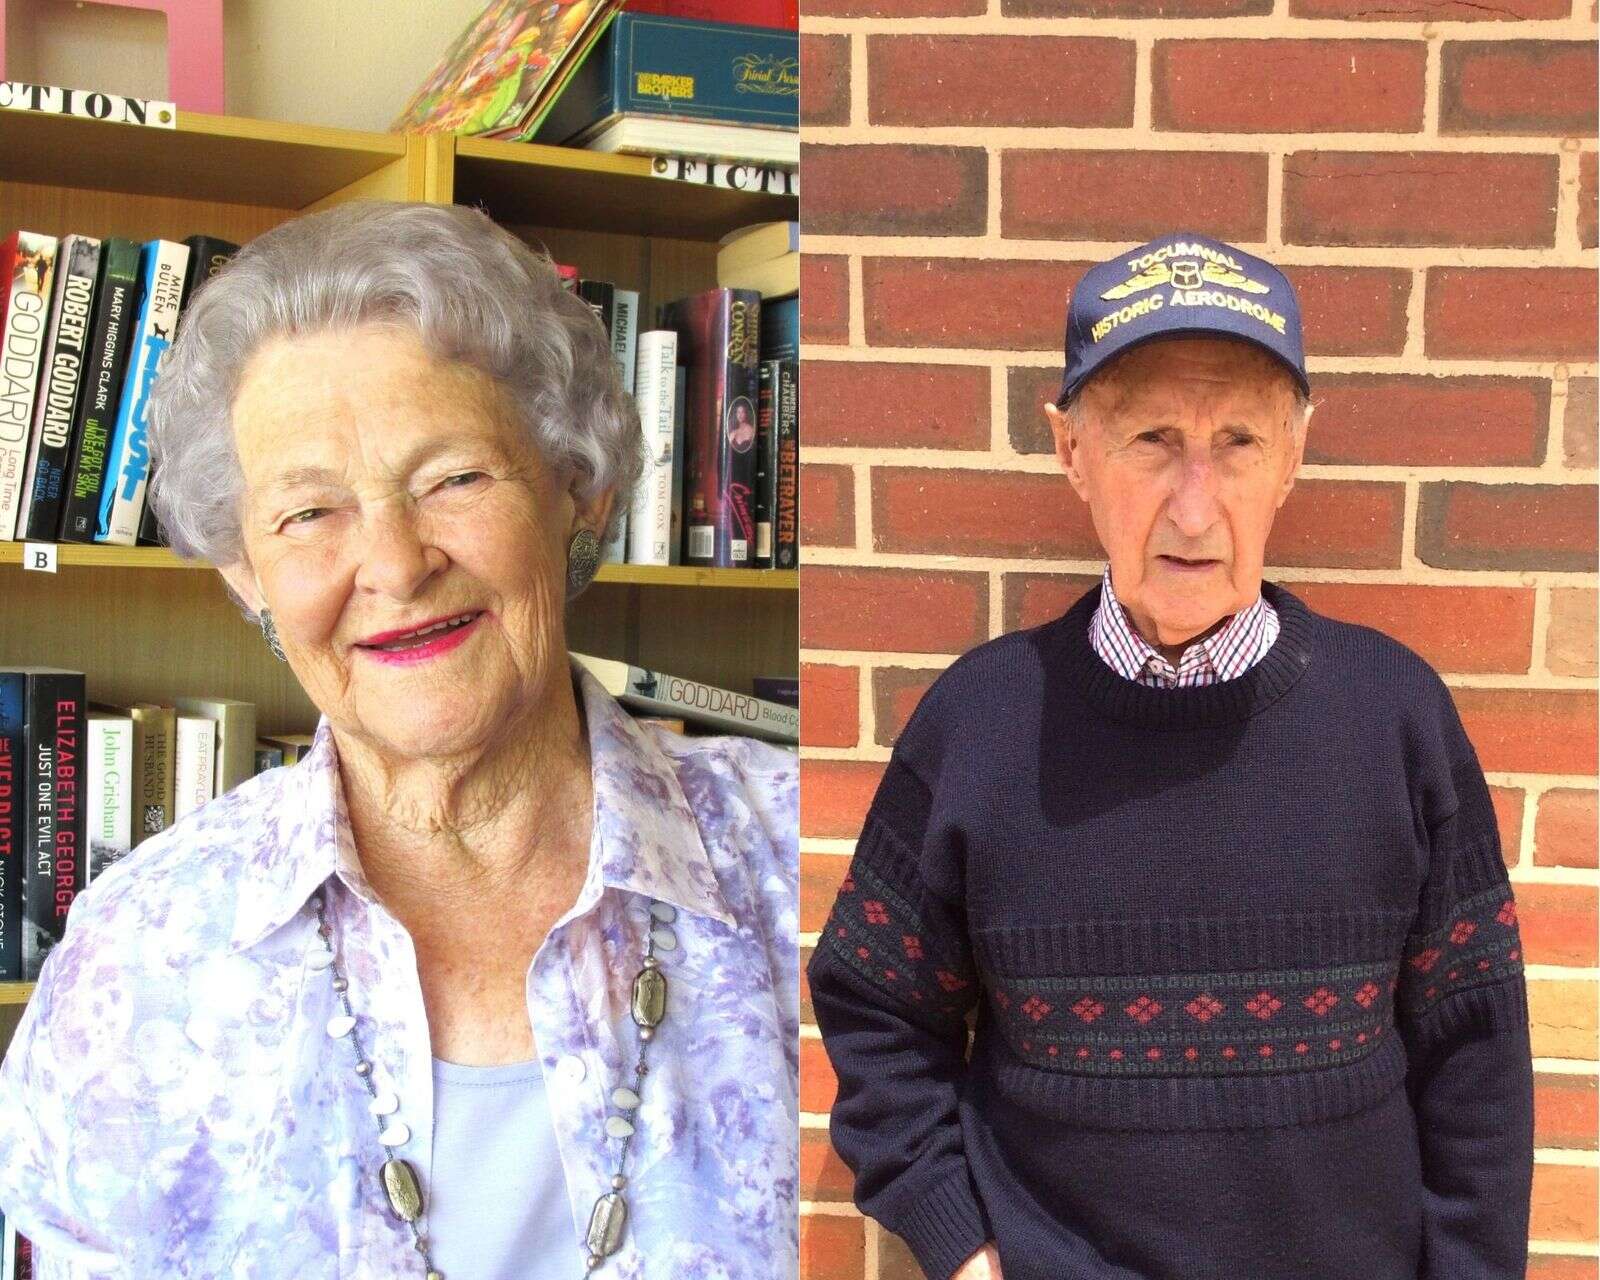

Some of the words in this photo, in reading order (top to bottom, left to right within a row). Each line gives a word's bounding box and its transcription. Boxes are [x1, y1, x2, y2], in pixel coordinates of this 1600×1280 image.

[654, 74, 693, 87] PARKER
[739, 65, 772, 82] Trivial
[637, 83, 693, 99] BROTHERS
[1128, 242, 1243, 272] TOCUMWAL
[110, 286, 125, 321] MARY
[154, 263, 171, 314] BULLEN
[166, 274, 181, 311] MIKE
[58, 274, 93, 351] ROBERT
[615, 302, 628, 353] MICHAEL
[1091, 294, 1163, 343] HISTORIC
[1170, 289, 1286, 335] AERODROME
[102, 321, 119, 369] HIGGINS
[730, 301, 748, 364] CONRAN
[0, 291, 43, 443] GODDARD
[661, 342, 675, 374] Talk
[95, 370, 111, 410] CLARK
[660, 376, 671, 388] to
[42, 353, 80, 448] GODDARD
[660, 390, 671, 407] the
[781, 371, 791, 435] CHAMBERS
[82, 418, 98, 453] UNDER
[659, 406, 673, 433] Tail
[5, 449, 21, 480] Long
[38, 458, 50, 474] GO
[79, 454, 92, 472] MY
[91, 450, 105, 471] GOT
[2, 482, 17, 511] Time
[35, 476, 48, 504] BACK
[48, 467, 62, 499] NEVER
[74, 473, 89, 498] SKIN
[87, 473, 100, 493] YOU
[658, 473, 666, 500] TOM
[779, 451, 796, 544] BETRAYER
[656, 504, 665, 530] COX
[34, 551, 48, 569] B
[669, 678, 760, 722] GODDARD
[762, 707, 788, 724] Blood
[38, 743, 52, 777] JUST
[103, 728, 121, 766] John
[158, 731, 167, 758] THE
[56, 701, 76, 822] ELIZABETH
[144, 735, 155, 799] HUSBAND
[38, 783, 51, 811] ONE
[157, 762, 167, 800] GOOD
[103, 771, 121, 839] Grisham
[38, 816, 51, 847] EVIL
[37, 851, 51, 877] ACT
[56, 831, 75, 917] GEORGE
